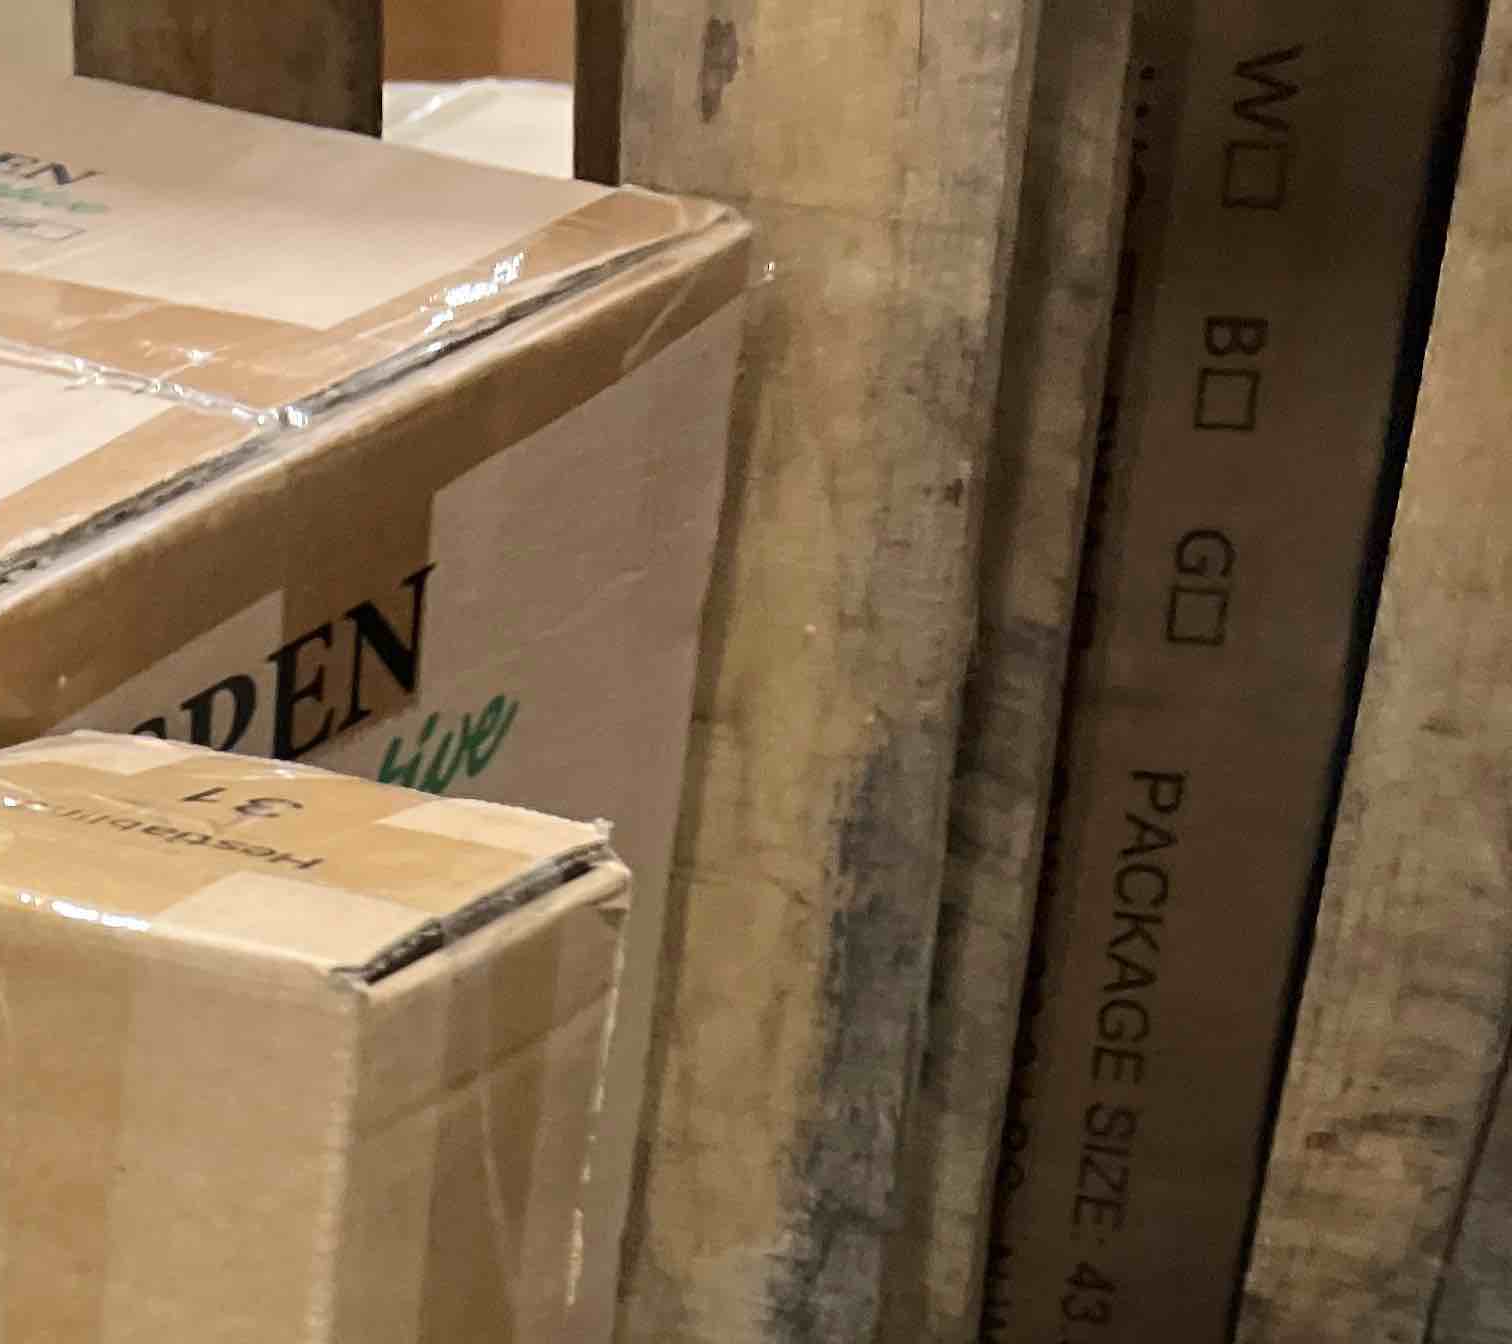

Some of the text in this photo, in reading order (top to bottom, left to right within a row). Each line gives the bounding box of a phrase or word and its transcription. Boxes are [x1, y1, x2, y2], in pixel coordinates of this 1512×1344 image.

[1232, 45, 1303, 132] W
[1205, 316, 1268, 357] B
[1177, 529, 1235, 577] G
[131, 562, 437, 762] PEN
[1092, 769, 1188, 1083] PACKAGE
